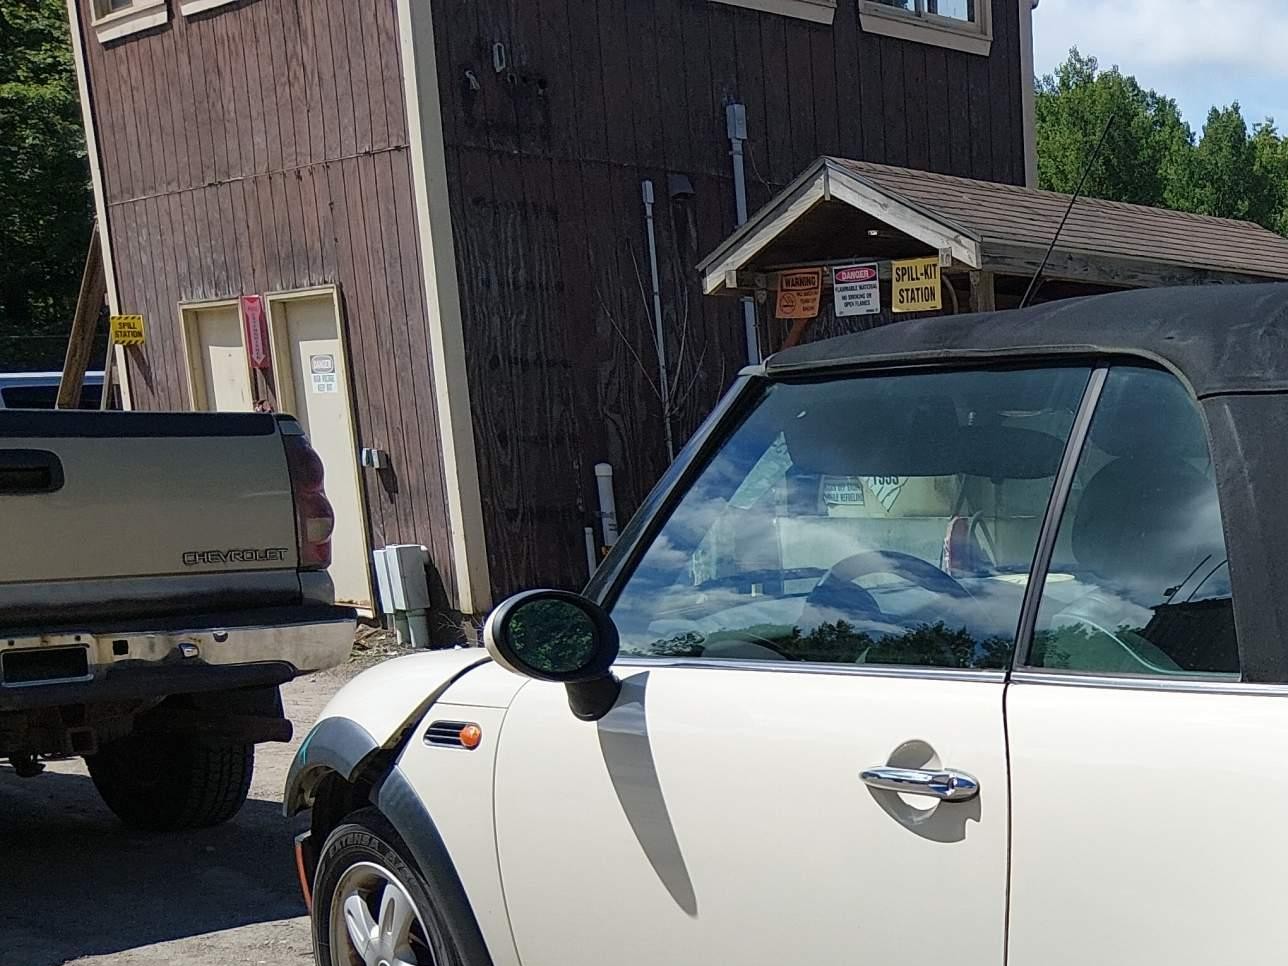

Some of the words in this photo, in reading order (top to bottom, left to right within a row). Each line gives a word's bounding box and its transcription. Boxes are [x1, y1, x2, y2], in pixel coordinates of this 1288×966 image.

[841, 269, 869, 280] DANGER
[895, 263, 938, 282] SPILL-KIT
[784, 276, 816, 288] WARNING
[898, 286, 936, 304] STATION
[118, 321, 137, 329] SPILL
[115, 330, 143, 338] STATION
[183, 548, 289, 565] CHEVROLET
